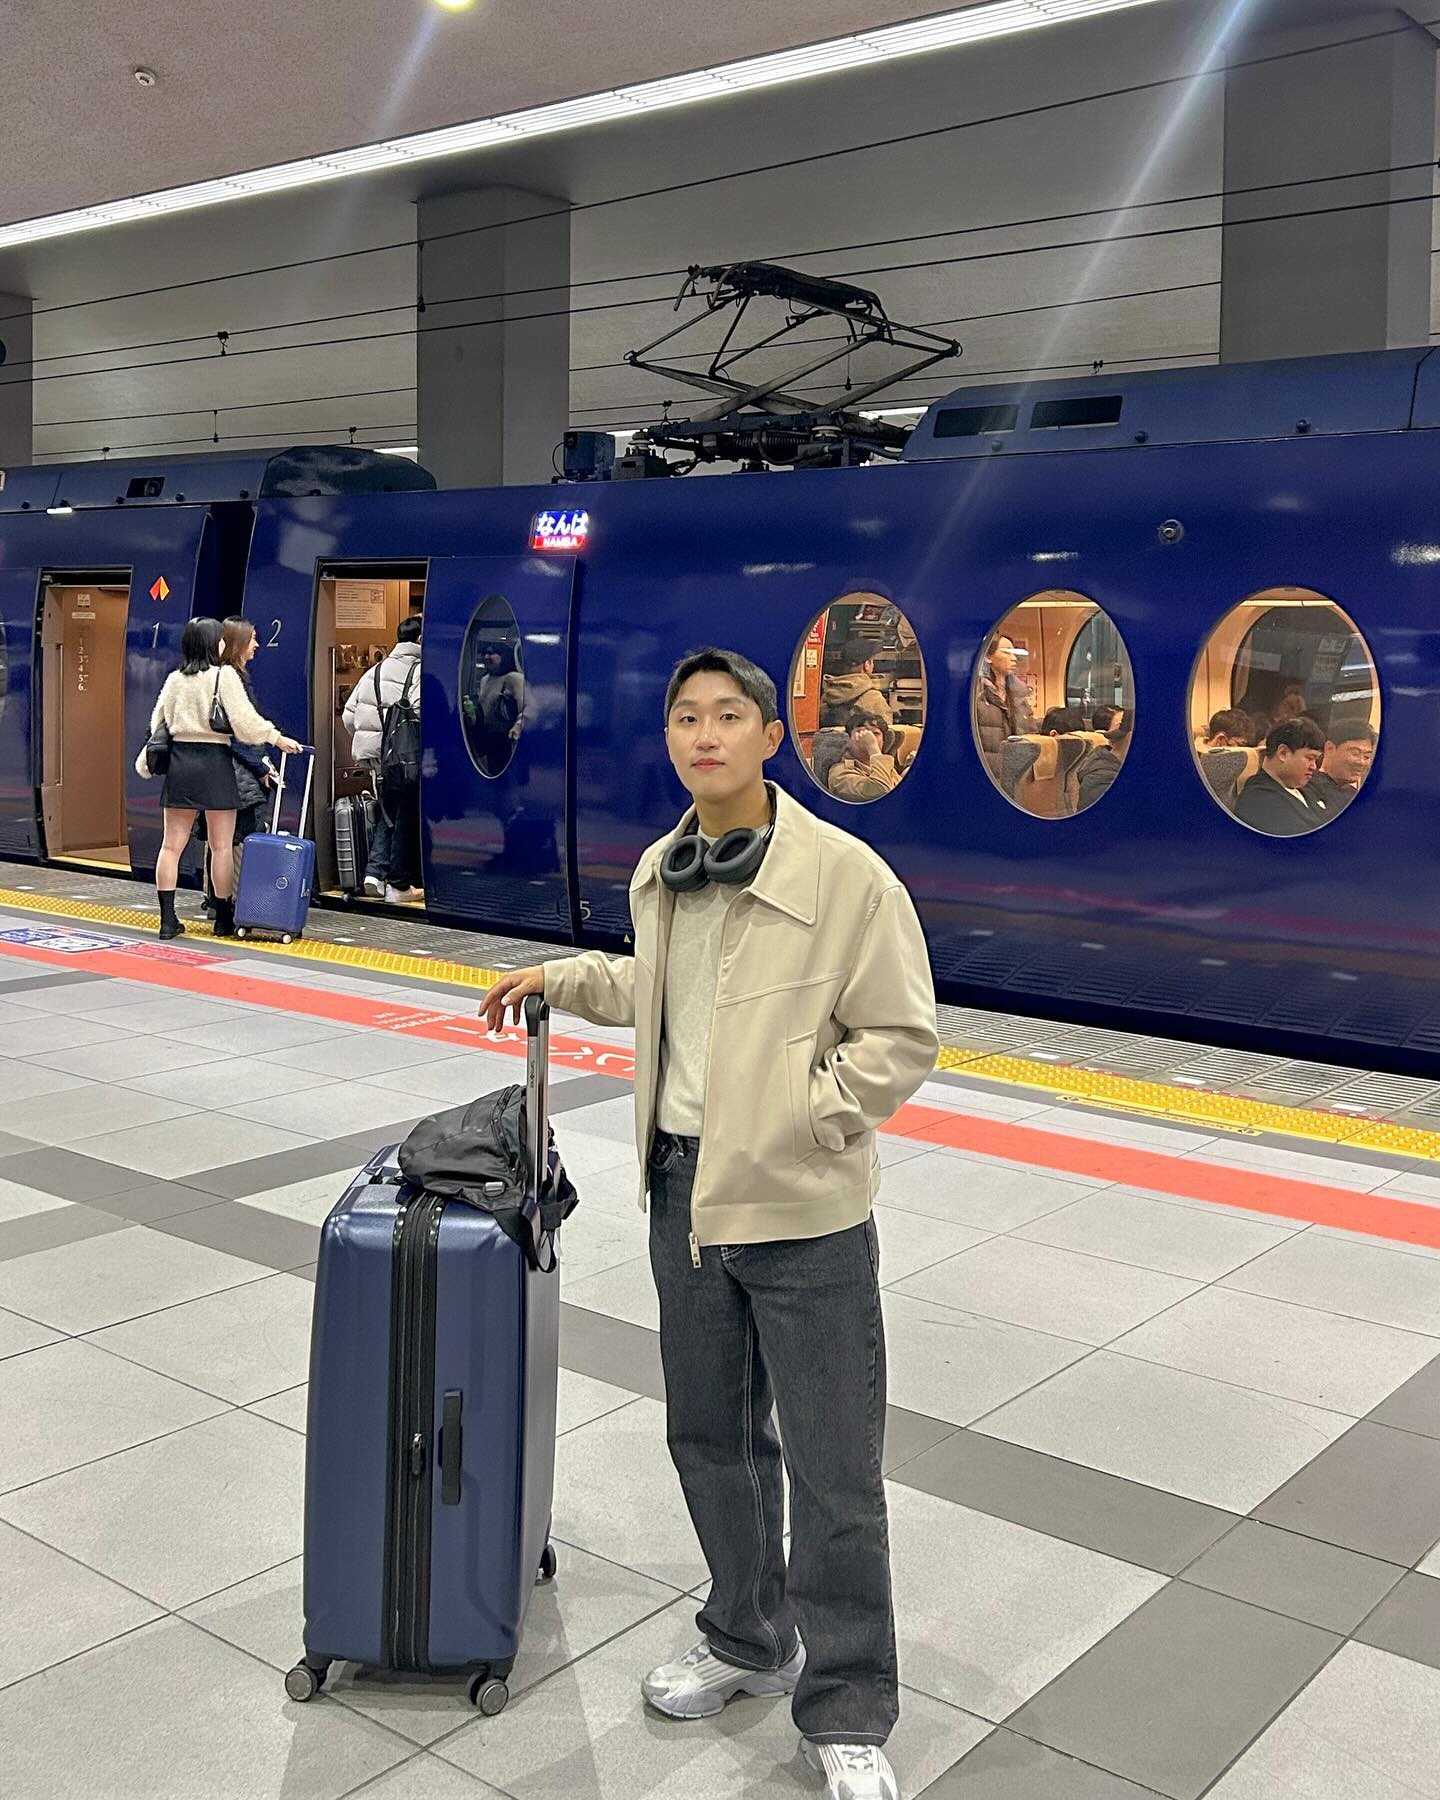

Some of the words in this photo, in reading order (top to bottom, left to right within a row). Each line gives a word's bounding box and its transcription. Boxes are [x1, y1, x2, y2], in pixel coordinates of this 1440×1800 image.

[152, 622, 160, 648] 1
[267, 619, 282, 647] 2
[580, 900, 591, 921] 5
